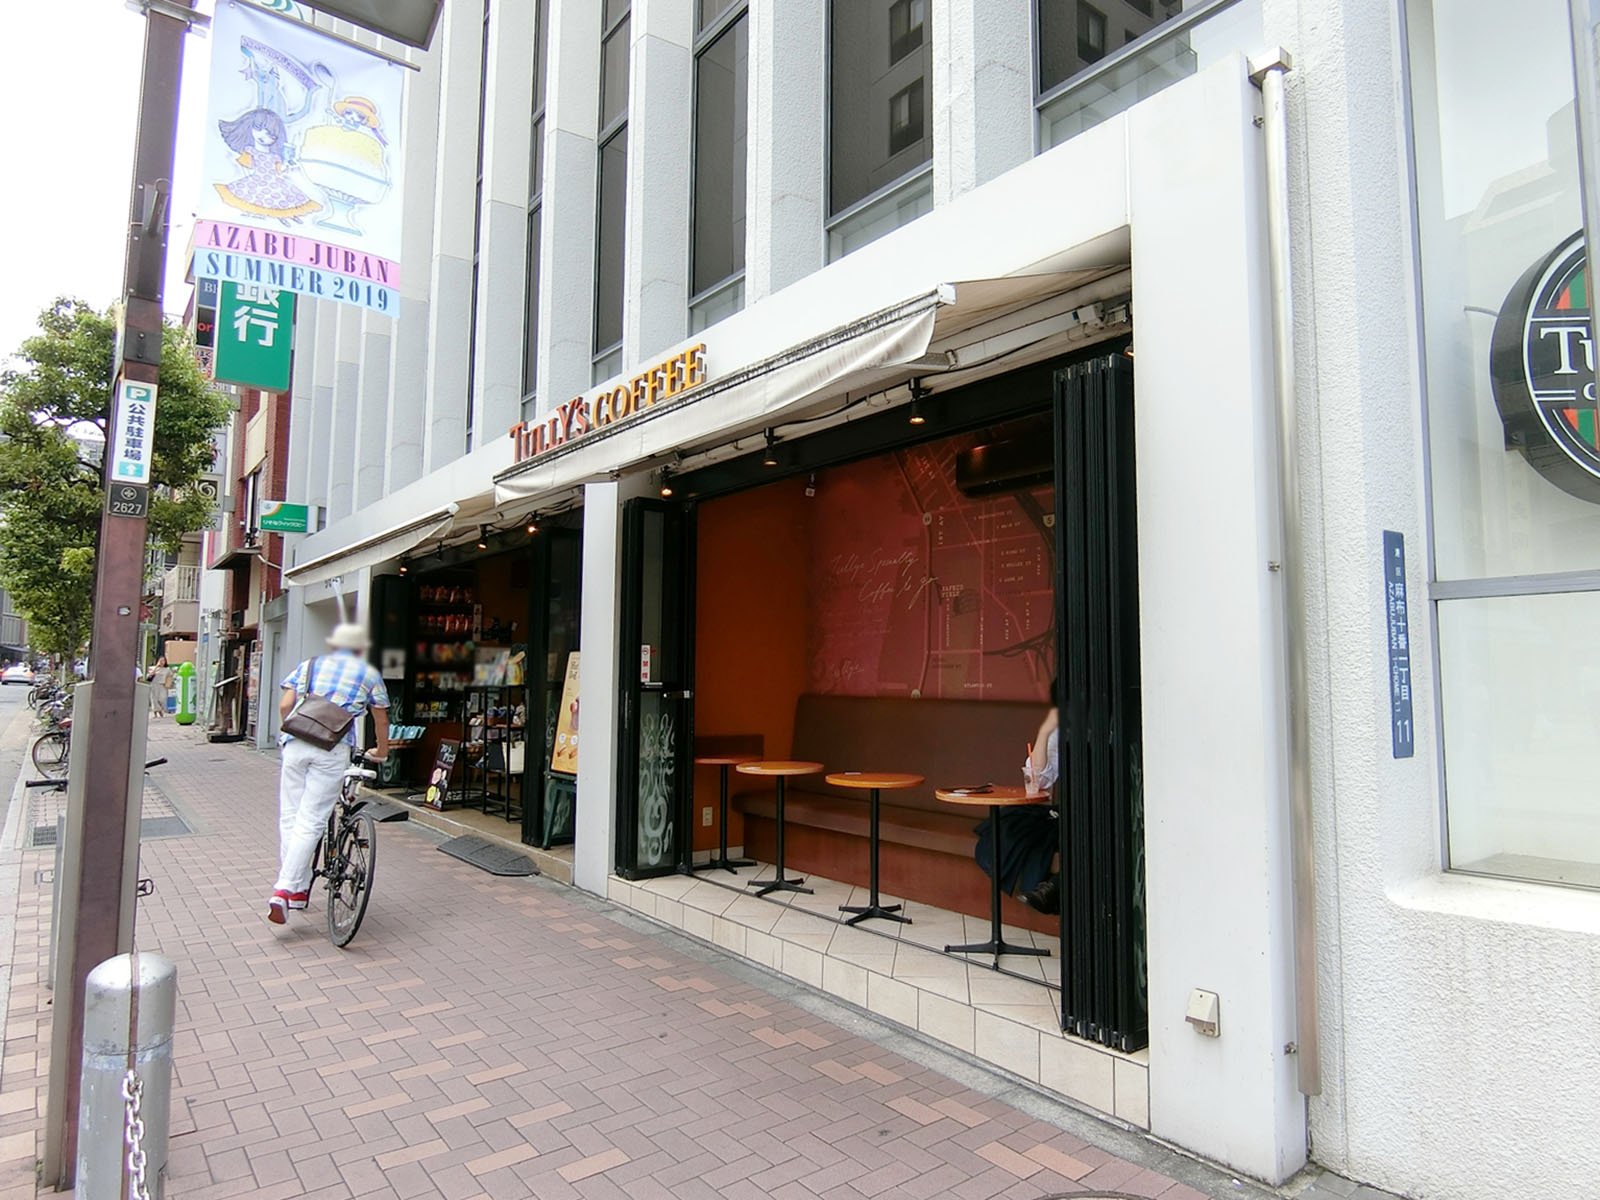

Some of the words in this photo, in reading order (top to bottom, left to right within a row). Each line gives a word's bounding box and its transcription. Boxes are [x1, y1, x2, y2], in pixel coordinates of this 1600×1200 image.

[206, 251, 325, 297] SUMMER
[333, 276, 389, 312] 2019
[207, 223, 297, 260] AZABU
[309, 245, 389, 284] JUBAN
[592, 343, 707, 430] COFFEE
[123, 402, 146, 461] 公共駐車場
[112, 501, 143, 515] 2627
[1396, 719, 1410, 744] 11
